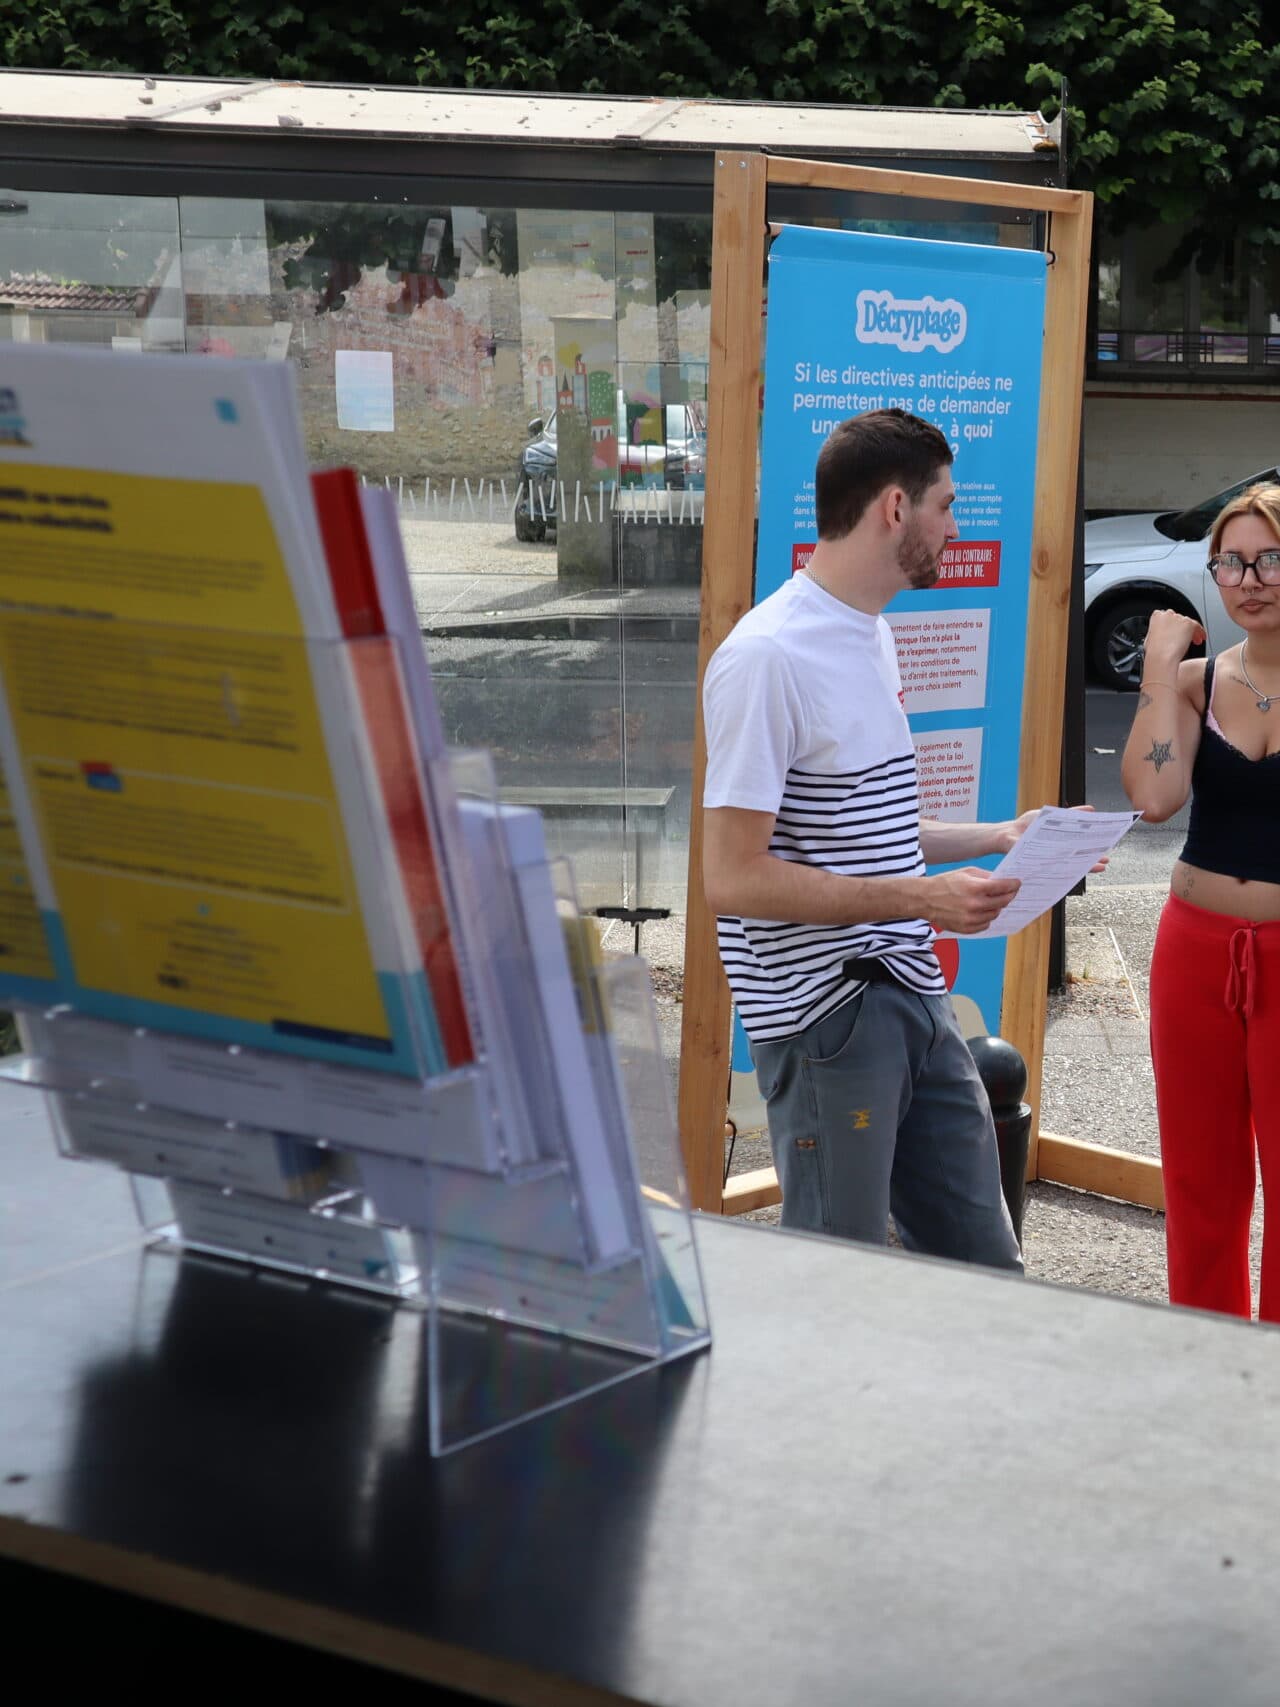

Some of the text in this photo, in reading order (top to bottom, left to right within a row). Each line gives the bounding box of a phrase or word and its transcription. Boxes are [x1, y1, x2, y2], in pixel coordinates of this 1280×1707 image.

[863, 300, 961, 342] Décryptage
[794, 362, 1013, 393] Si les directives anticipées ne
[793, 392, 1011, 415] permettent pas de demander
[950, 417, 960, 437] à
[963, 420, 993, 442] quoi
[977, 494, 1002, 505] compte
[985, 506, 1001, 515] donc
[943, 550, 954, 563] BIEN
[955, 550, 962, 563] AU
[962, 549, 993, 563] CONTRAIRE
[940, 564, 985, 579] DE LA FIN DE VIE.
[891, 624, 922, 633] ermettent
[923, 622, 932, 630] de
[932, 622, 945, 631] faire
[946, 621, 974, 630] entendre
[941, 634, 953, 643] plus
[954, 633, 960, 641] la
[941, 644, 977, 654] notamment
[920, 657, 950, 667] conditions
[951, 657, 960, 665] de
[925, 682, 940, 691] choix
[941, 680, 962, 690] soient
[953, 741, 962, 749] de
[920, 754, 935, 764] cadre
[937, 753, 945, 762] de
[946, 753, 953, 761] la
[954, 752, 964, 761] loi
[936, 764, 973, 774] notamment
[946, 775, 975, 786] profonde
[944, 787, 961, 797] dans
[962, 786, 971, 795] les
[943, 799, 948, 808] à
